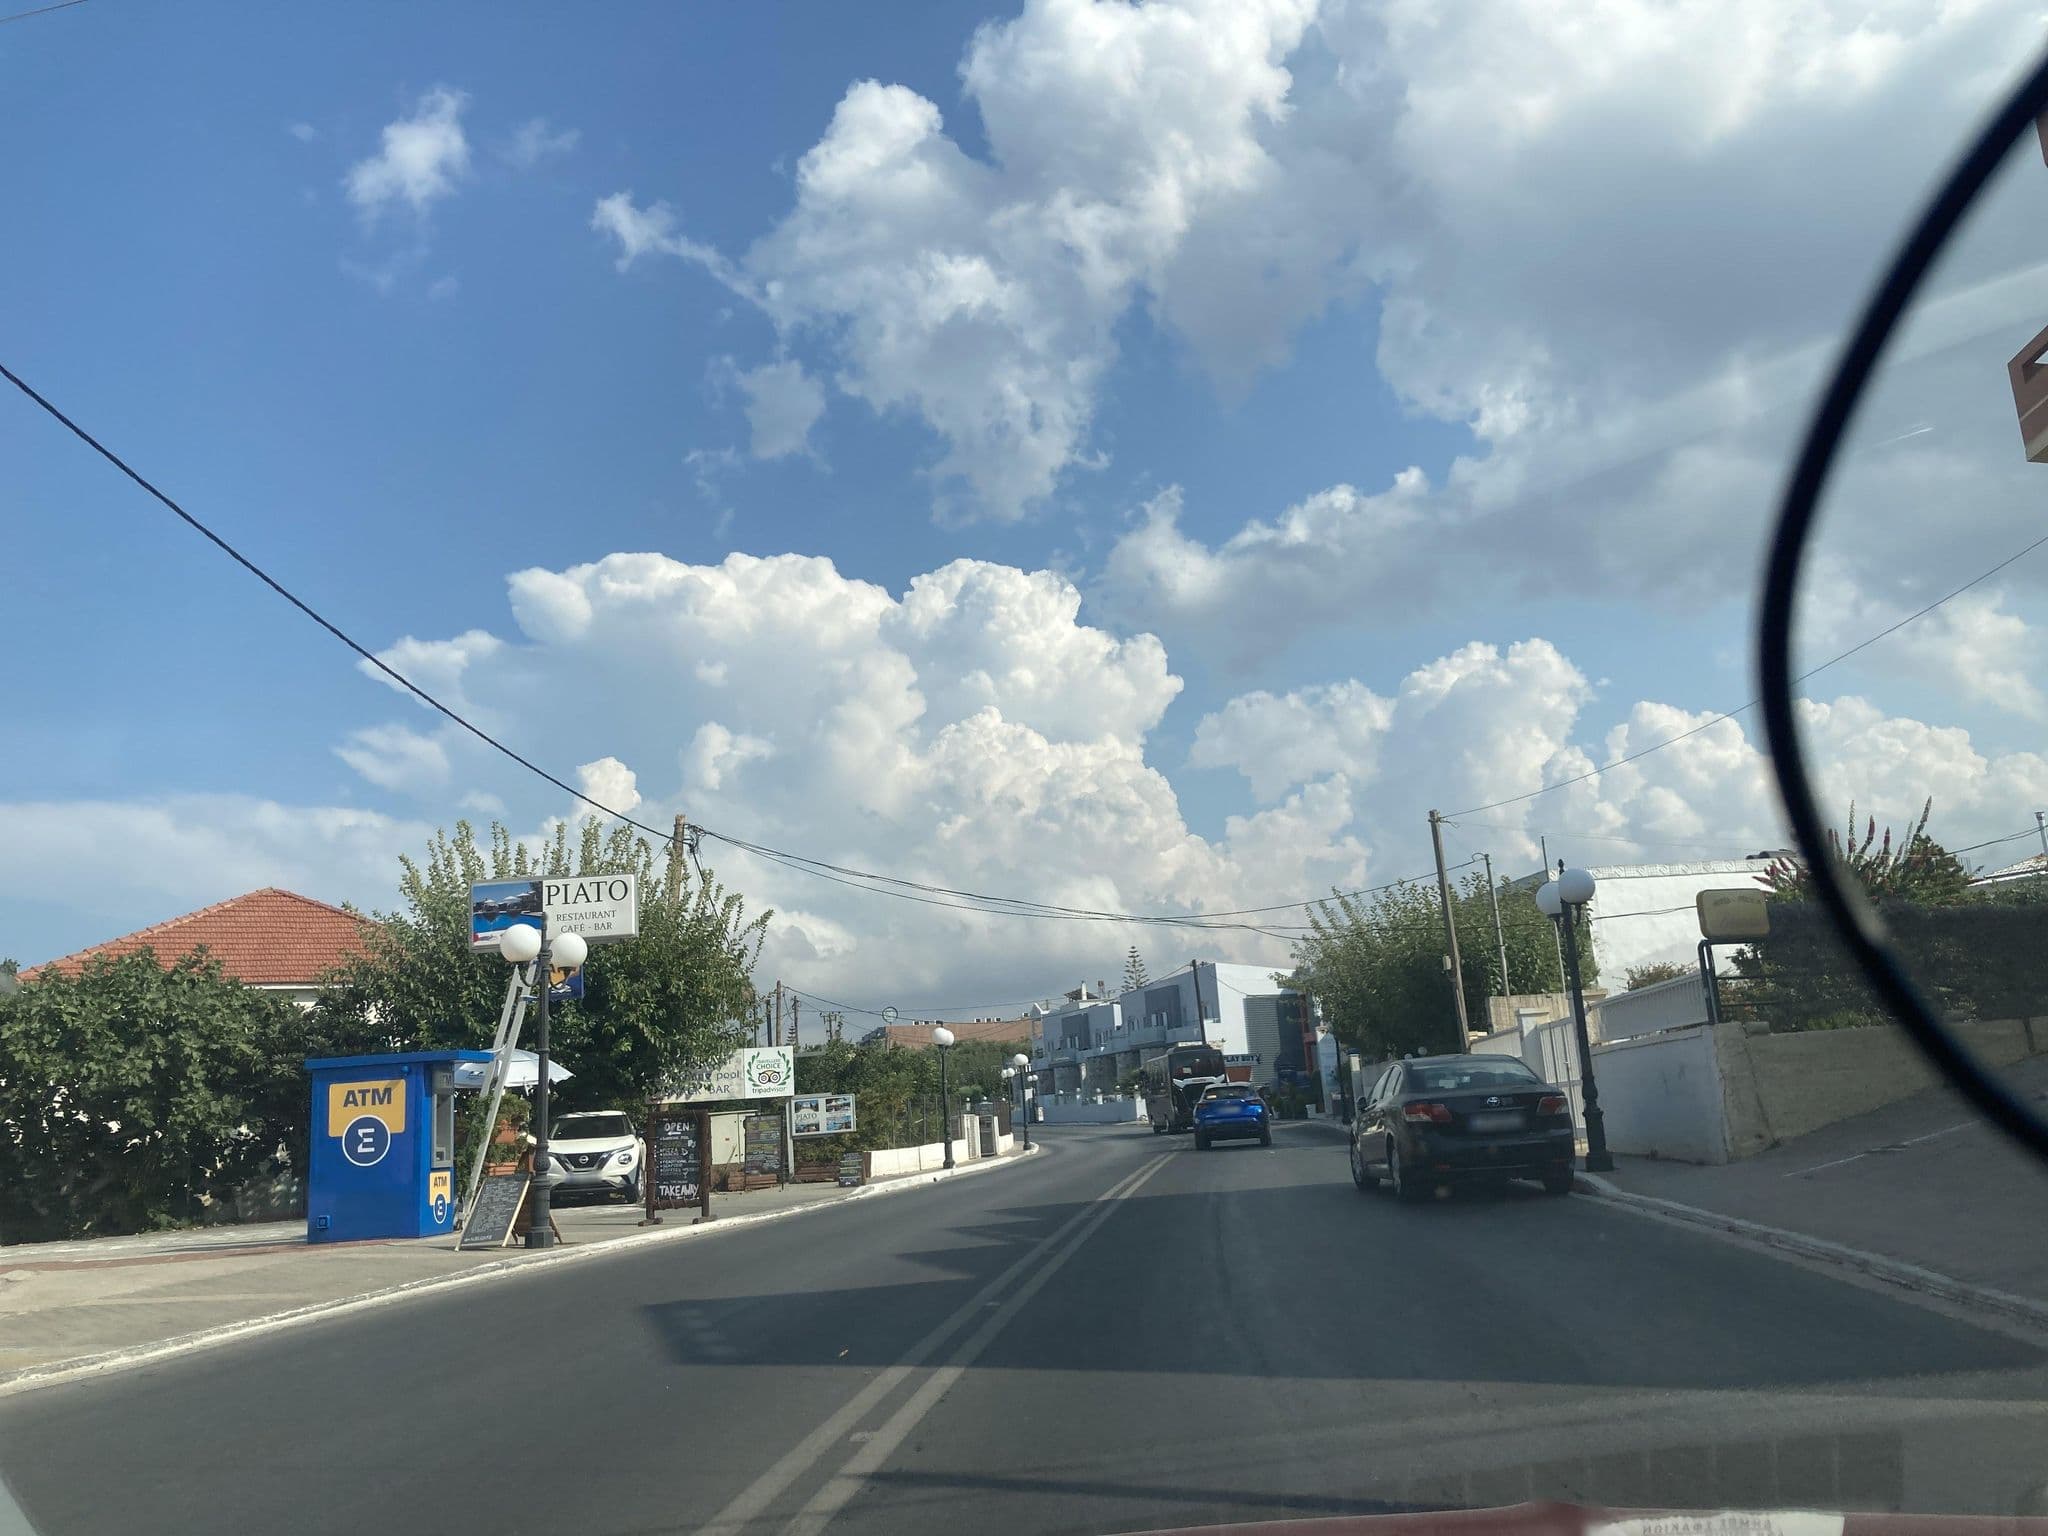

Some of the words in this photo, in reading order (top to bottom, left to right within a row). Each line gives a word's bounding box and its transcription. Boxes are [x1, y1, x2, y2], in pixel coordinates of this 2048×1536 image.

[545, 879, 628, 906] PIATO
[556, 909, 616, 921] RESTAURANT
[560, 922, 585, 933] CAFÉ
[594, 921, 613, 931] BAR
[756, 1062, 781, 1070] CHOICE
[716, 1070, 740, 1081] pool
[710, 1085, 730, 1096] BAR
[752, 1086, 786, 1094] tripadvisor
[343, 1087, 392, 1108] ATM
[796, 1112, 817, 1121] PIATO
[664, 1122, 690, 1132] OPEN
[434, 1176, 448, 1188] ATM
